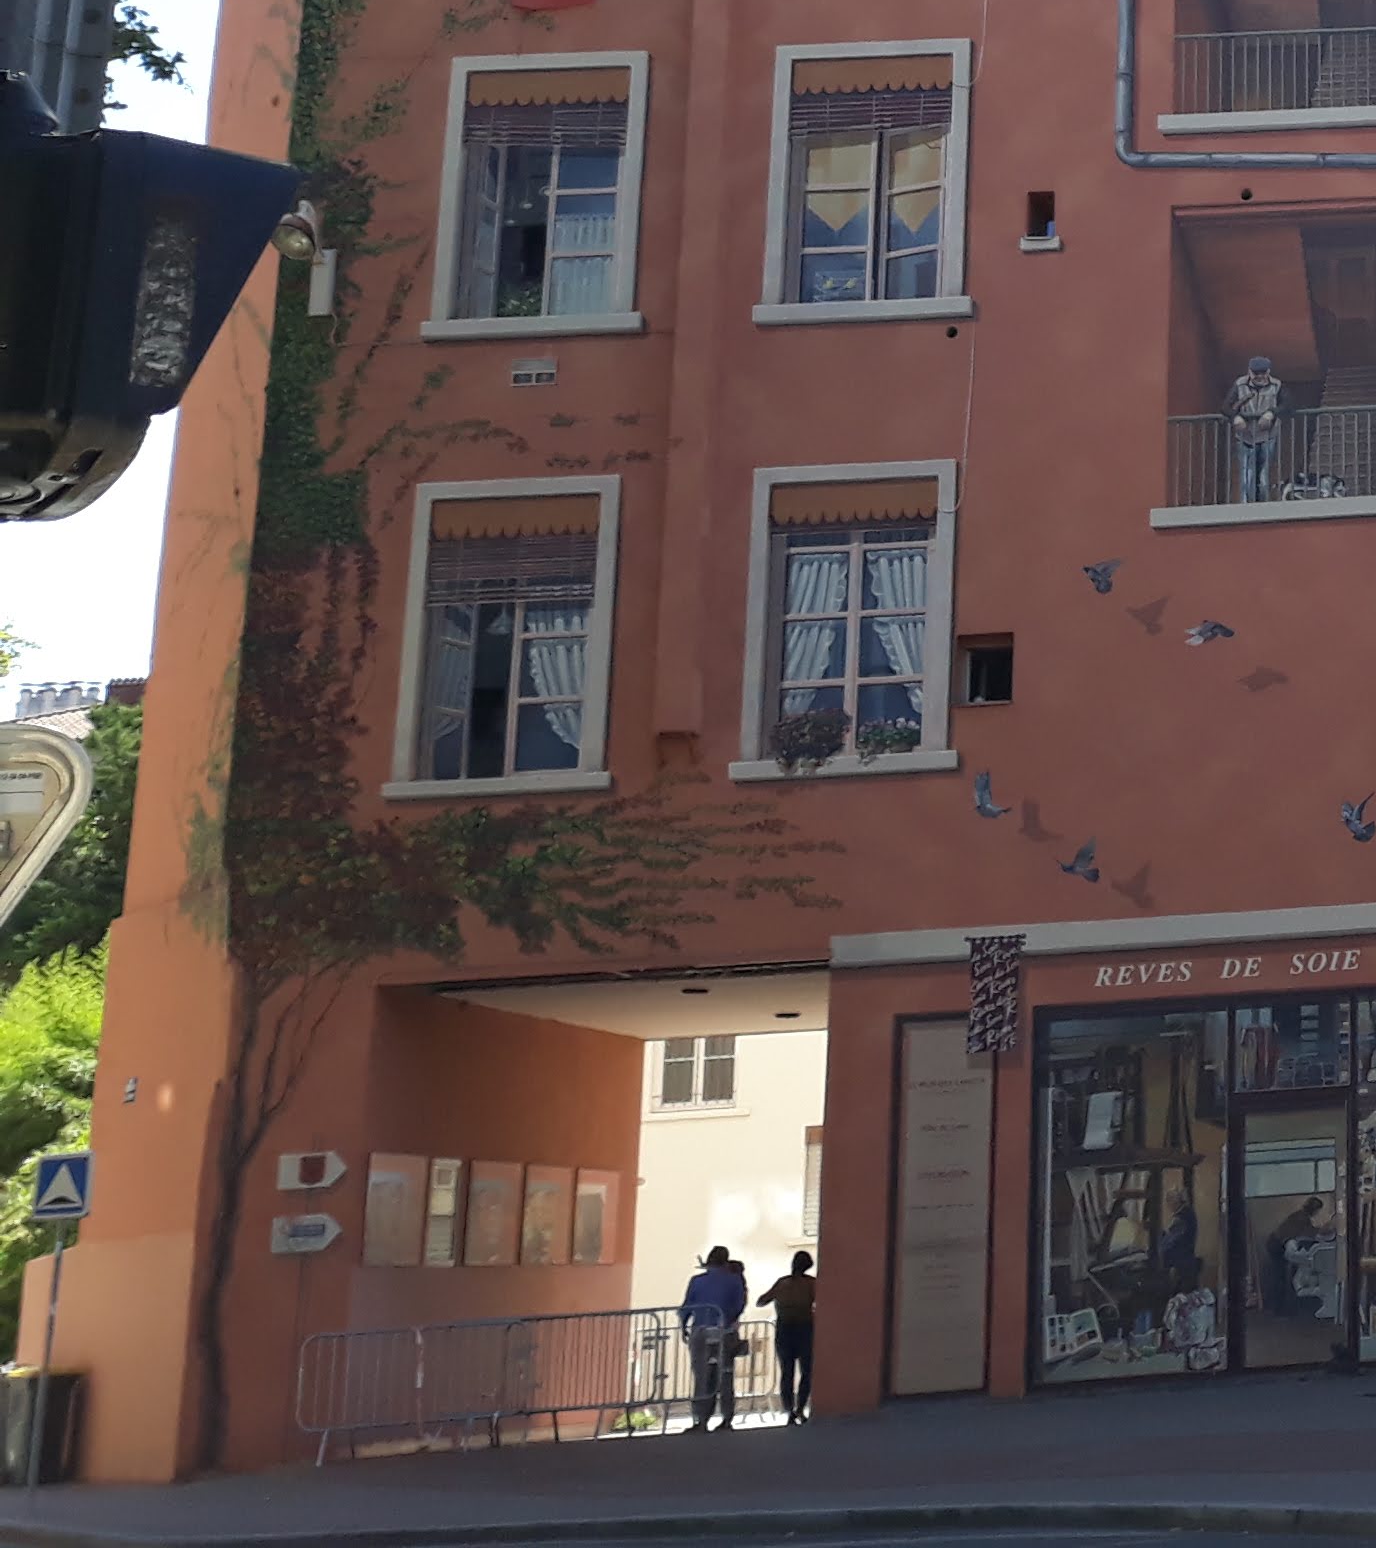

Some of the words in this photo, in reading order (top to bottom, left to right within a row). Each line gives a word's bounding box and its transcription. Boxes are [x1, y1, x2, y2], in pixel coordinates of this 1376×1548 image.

[1094, 960, 1193, 987] REVES
[1220, 956, 1262, 979] DE
[1289, 949, 1361, 975] SOIE
